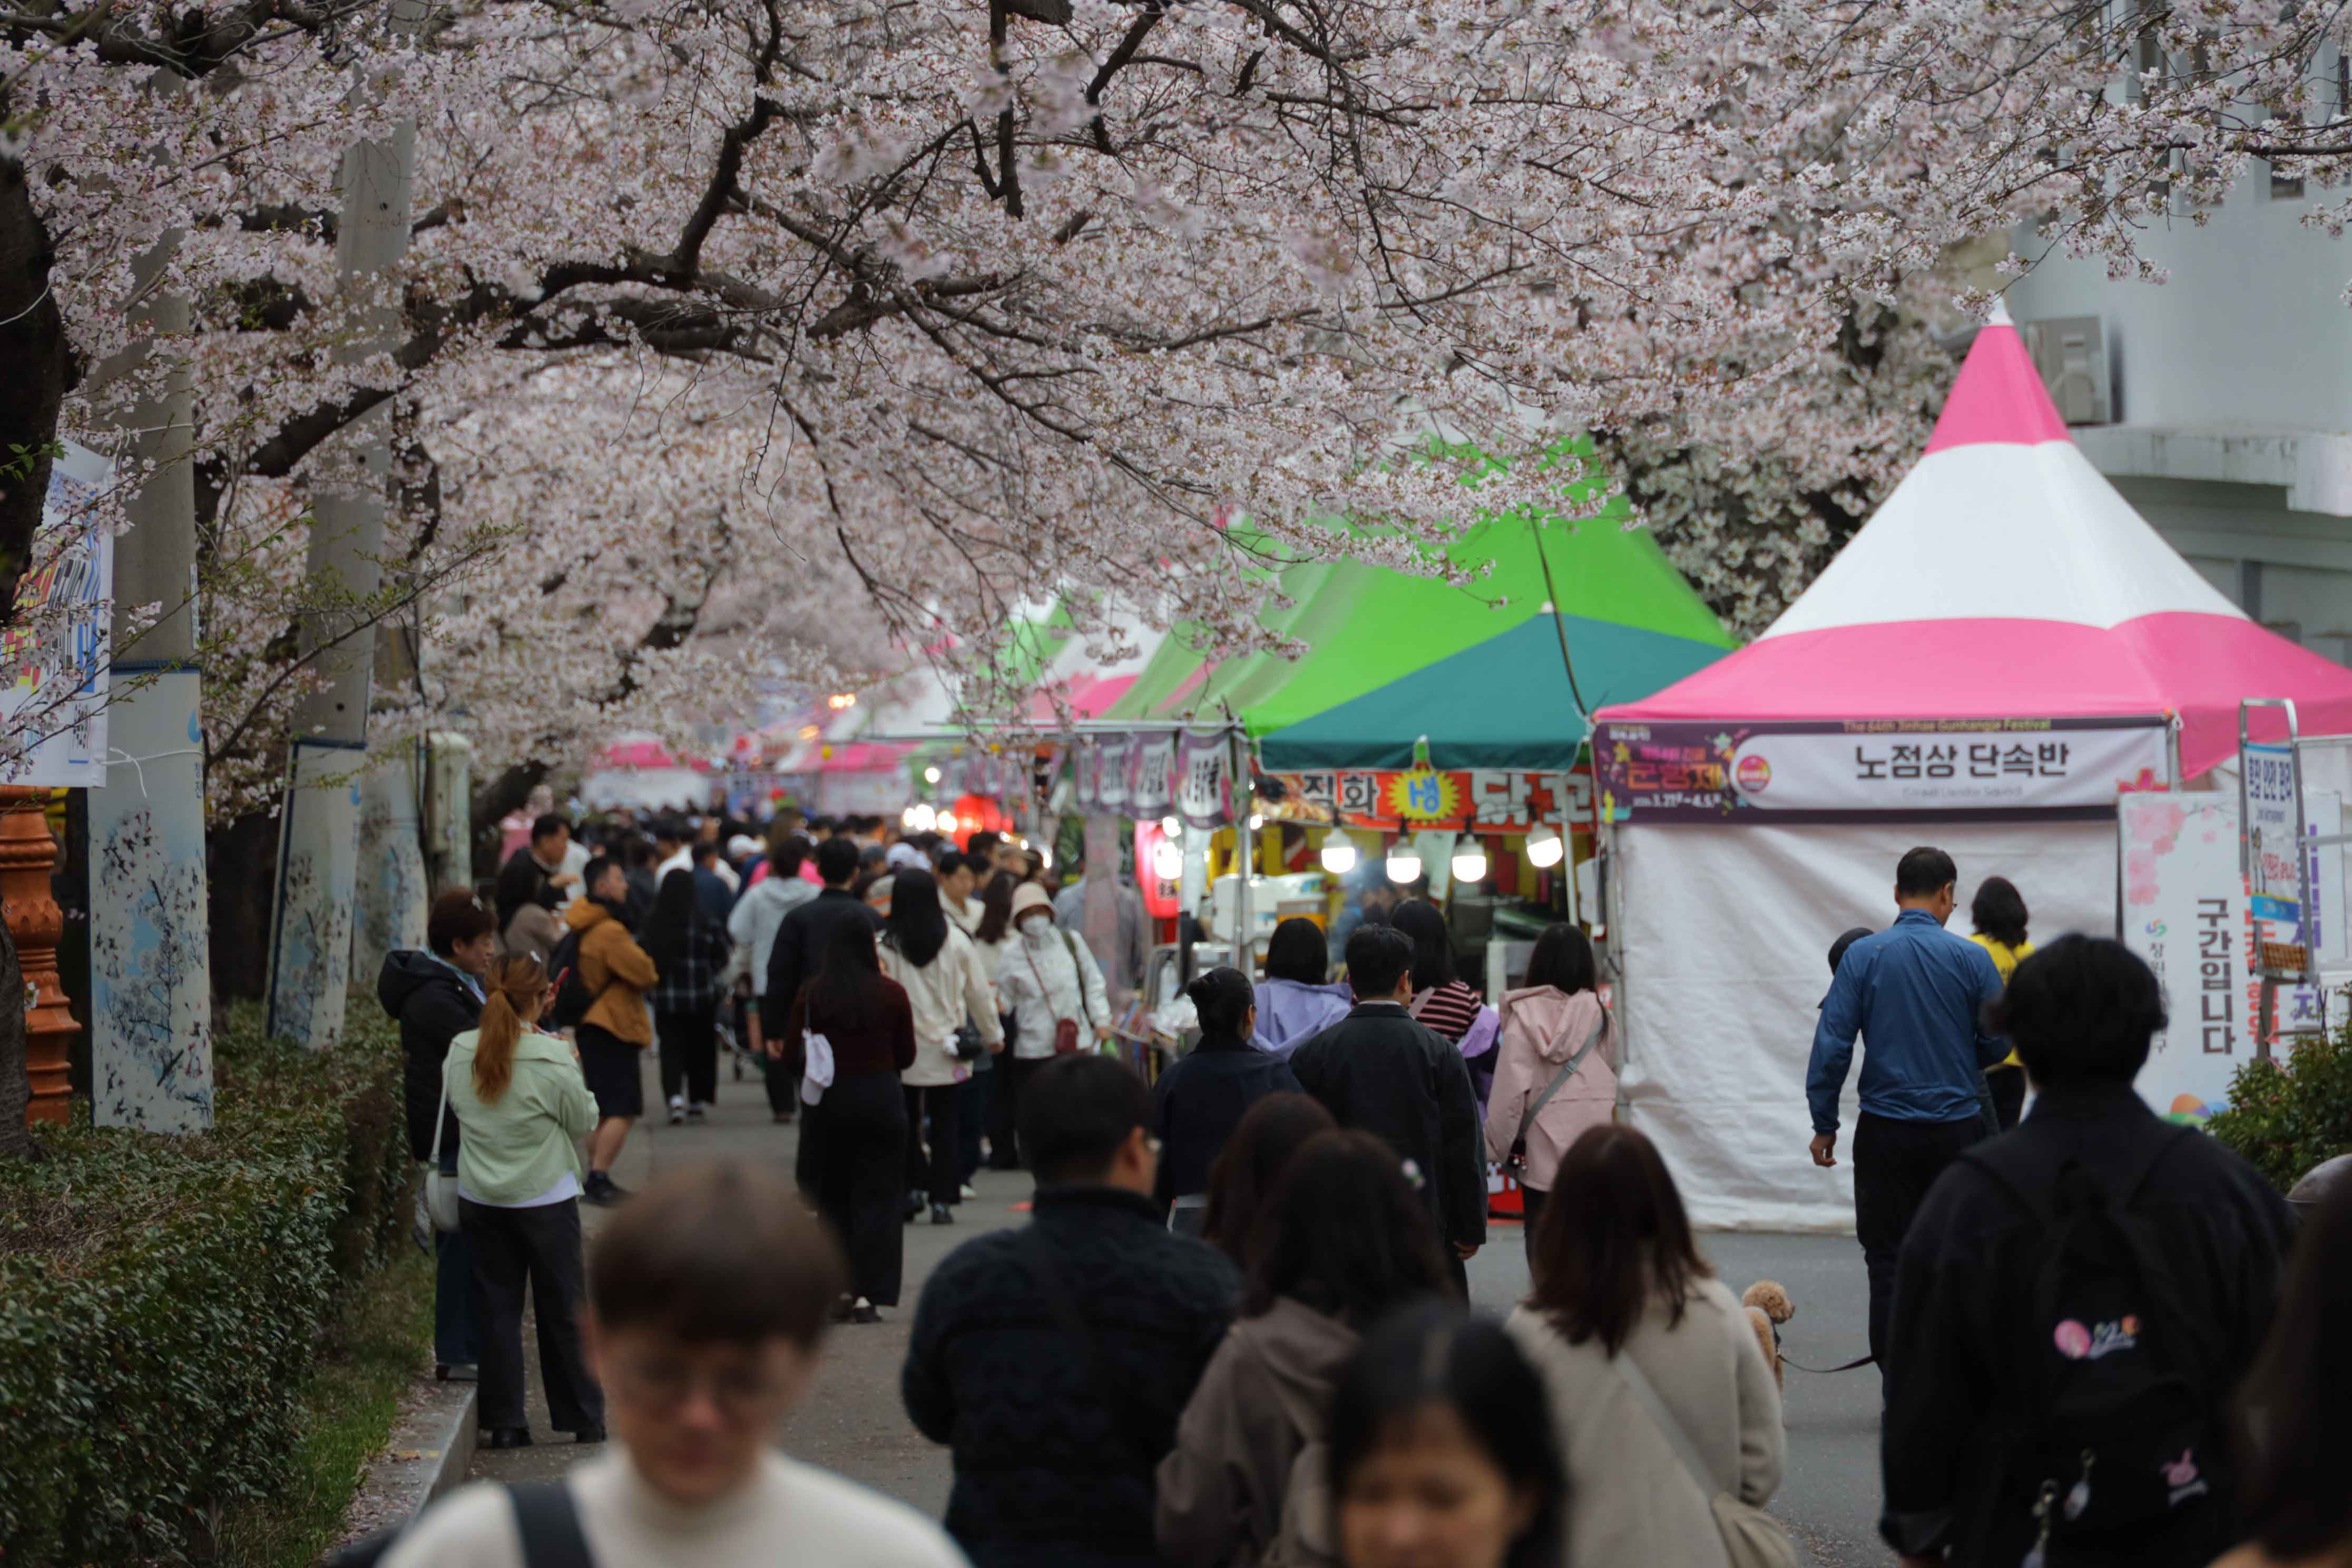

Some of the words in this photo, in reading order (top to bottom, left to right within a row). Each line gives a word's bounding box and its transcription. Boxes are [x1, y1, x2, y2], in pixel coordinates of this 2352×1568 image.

[1856, 743, 1958, 779] 노점상
[1969, 742, 2070, 777] 단속반
[1303, 775, 1378, 812] 직화
[2197, 898, 2236, 1055] 구간입니다
